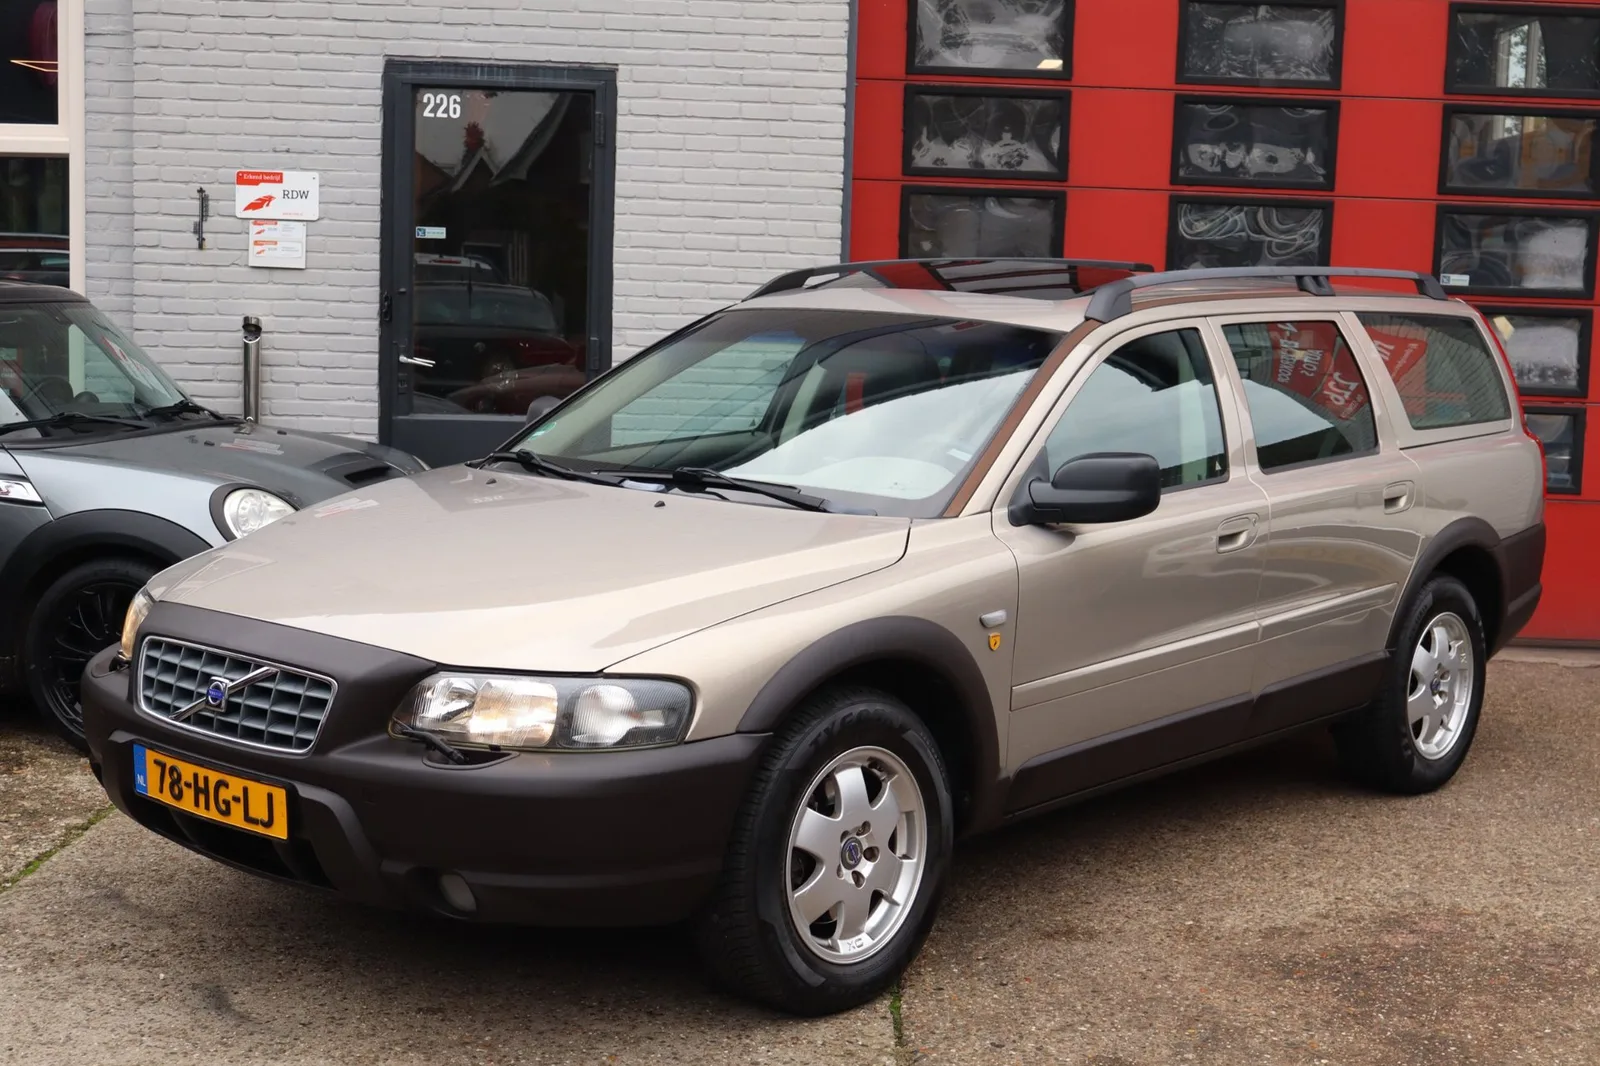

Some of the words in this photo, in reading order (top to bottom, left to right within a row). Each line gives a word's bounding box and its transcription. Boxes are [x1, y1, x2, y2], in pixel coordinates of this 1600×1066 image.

[422, 92, 461, 119] 226
[282, 189, 310, 200] RDW
[136, 773, 146, 787] NL
[153, 758, 274, 829] 78-HG-LJ
